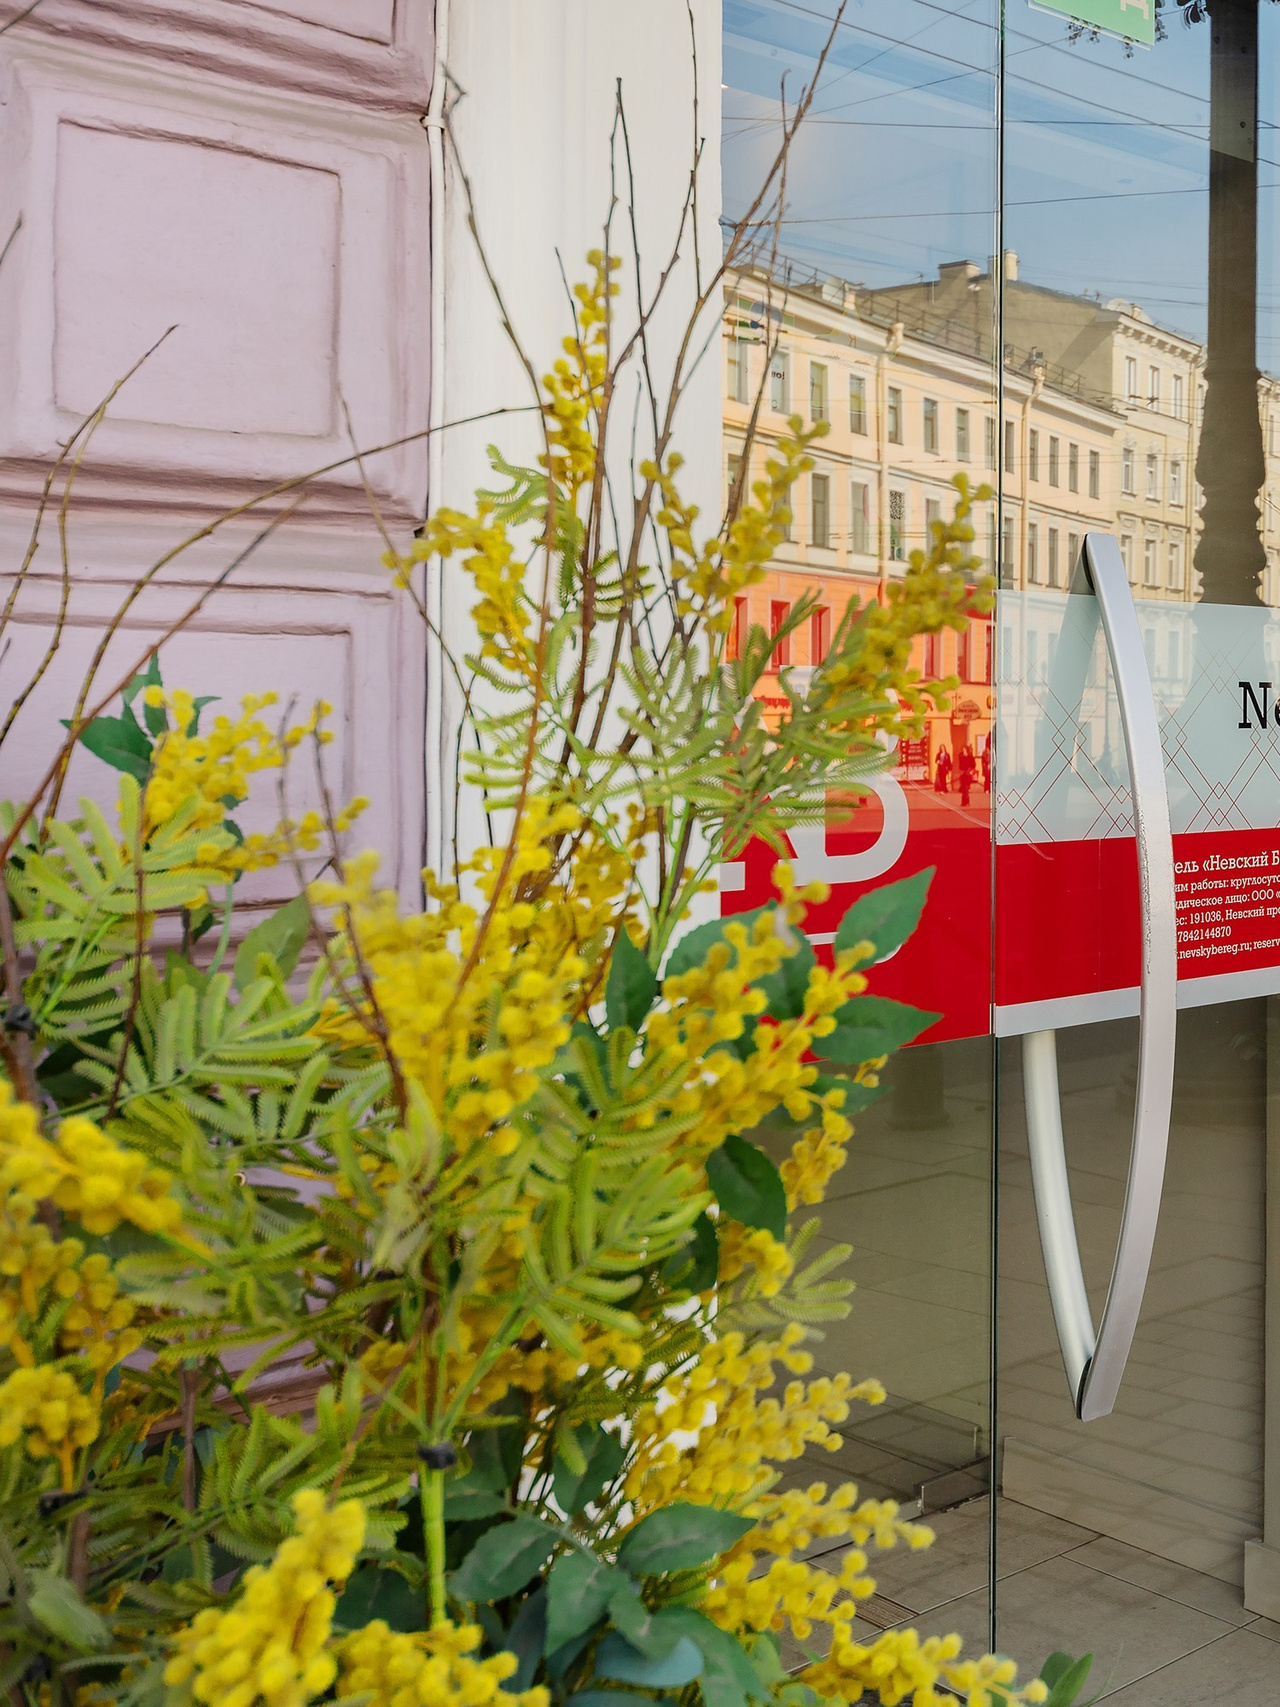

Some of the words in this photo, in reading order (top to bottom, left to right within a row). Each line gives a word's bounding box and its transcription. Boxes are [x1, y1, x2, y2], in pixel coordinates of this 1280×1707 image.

[1174, 860, 1199, 874] ель
[1202, 851, 1269, 872] «Невский
[1174, 883, 1188, 893] им
[1190, 878, 1229, 894] работы:
[1224, 893, 1250, 904] лицо:
[1251, 888, 1274, 901] ООО
[1175, 916, 1187, 926] ес:
[1190, 910, 1224, 925] 191036,
[1225, 906, 1265, 920] Невский
[1177, 925, 1232, 943] 7842144870
[1176, 939, 1253, 959] .nevskybereg.ru;
